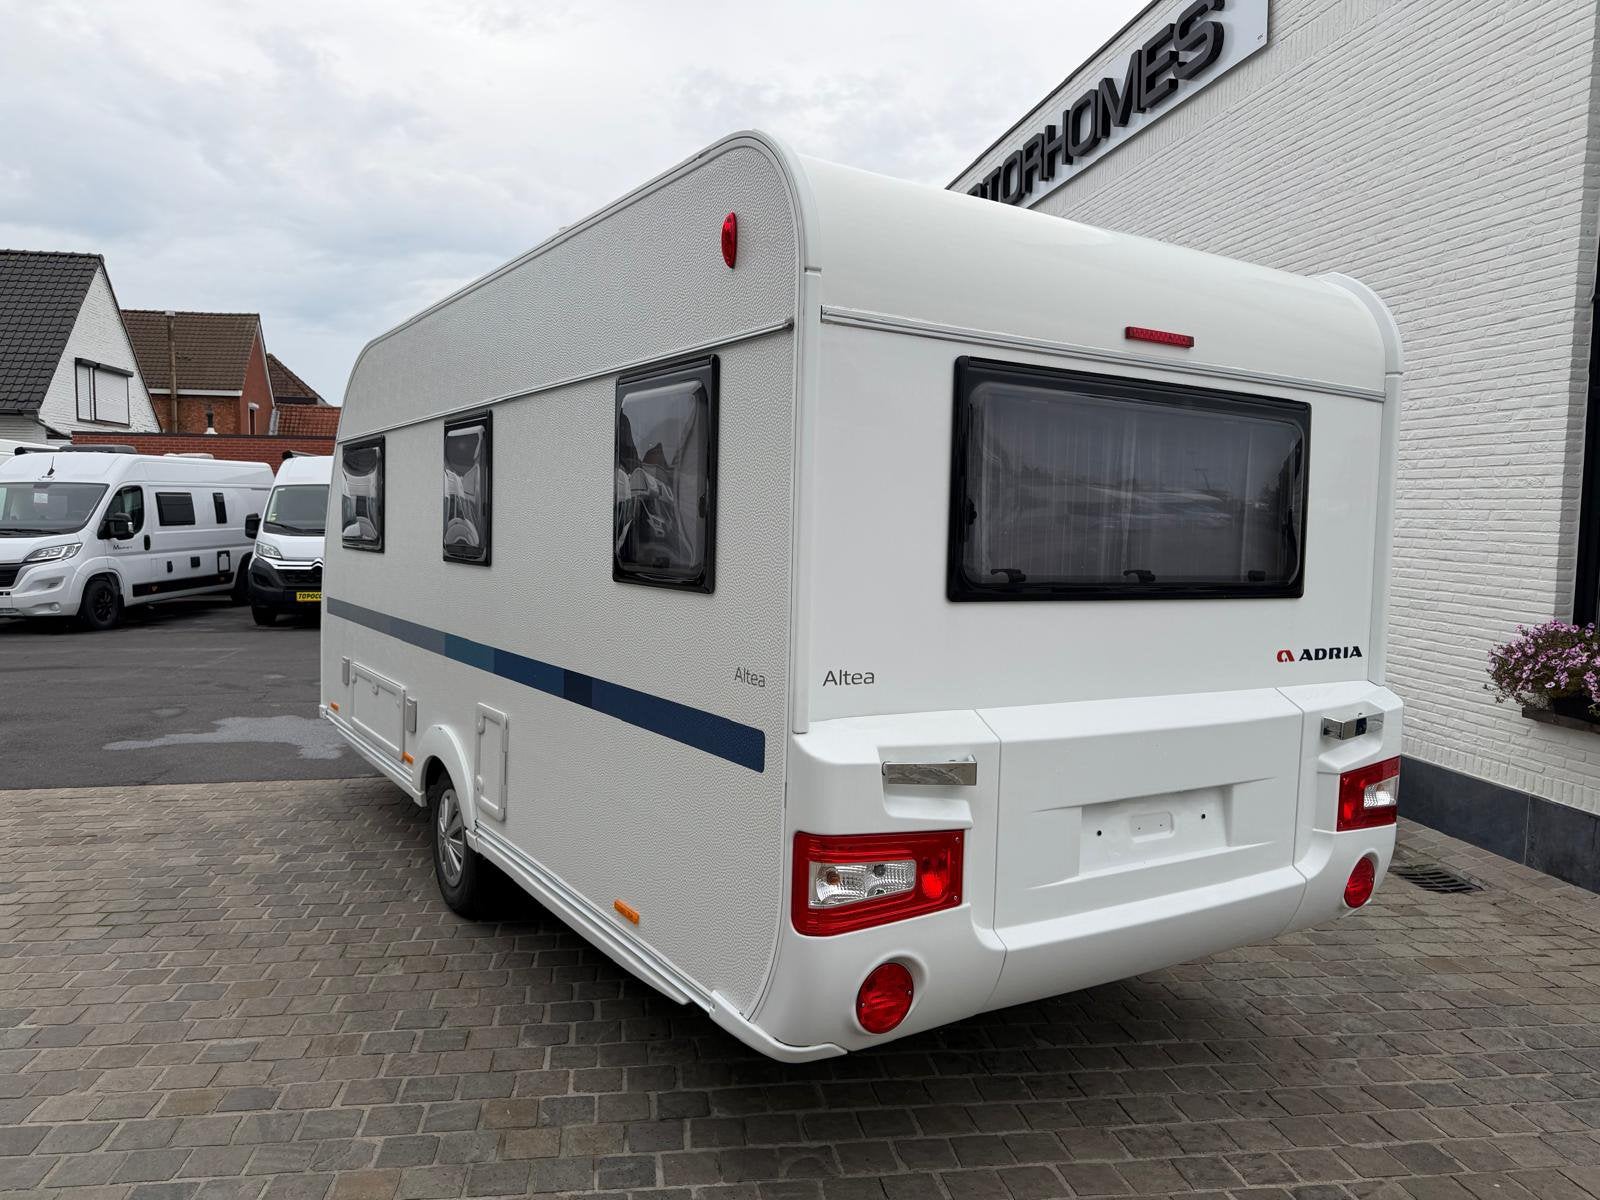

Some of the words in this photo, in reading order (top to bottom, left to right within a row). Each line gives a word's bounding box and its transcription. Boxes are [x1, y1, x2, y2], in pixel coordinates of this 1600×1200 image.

[1298, 645, 1363, 662] ADRIA
[734, 666, 766, 688] Altea
[822, 669, 875, 687] Altea
